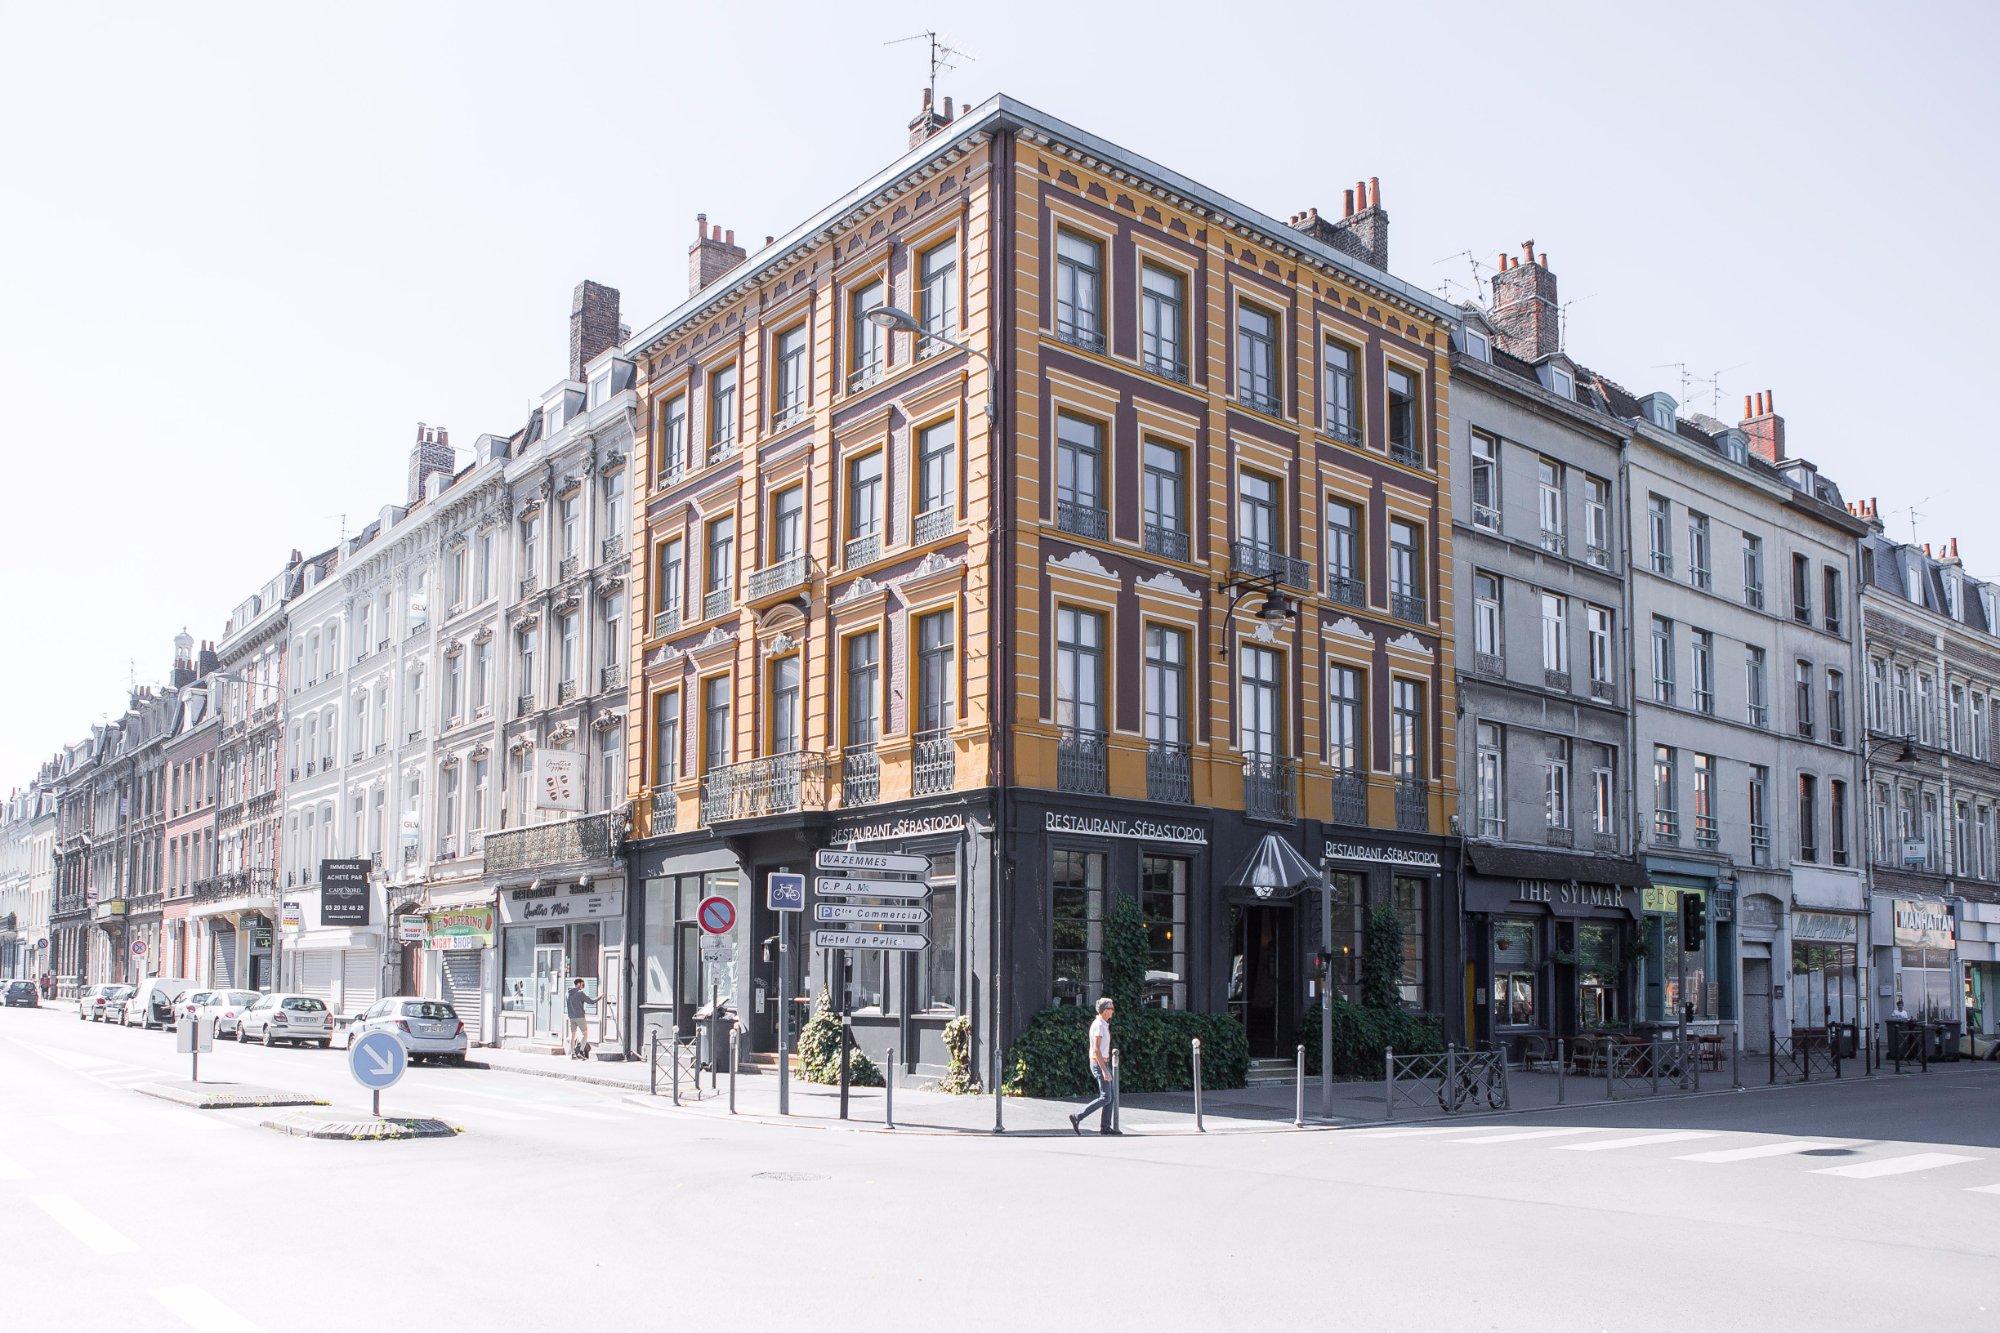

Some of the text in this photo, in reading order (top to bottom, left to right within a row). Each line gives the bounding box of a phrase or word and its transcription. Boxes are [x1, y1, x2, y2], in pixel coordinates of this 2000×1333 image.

[831, 813, 965, 844] RESTAURANT SÉBASTOPOL
[1045, 811, 1208, 842] RESTAURANT SÉBASTOPOL
[823, 855, 888, 867] WAZEMMES
[1325, 841, 1440, 865] RESTAURANT SÉBASTOPOL
[327, 873, 349, 881] ACHETÉ
[1516, 880, 1625, 907] THE SYLMAR
[857, 910, 922, 920] Commercial
[1900, 910, 1955, 932] MANHATTAN
[453, 936, 471, 948] SHOP
[854, 936, 867, 944] de
